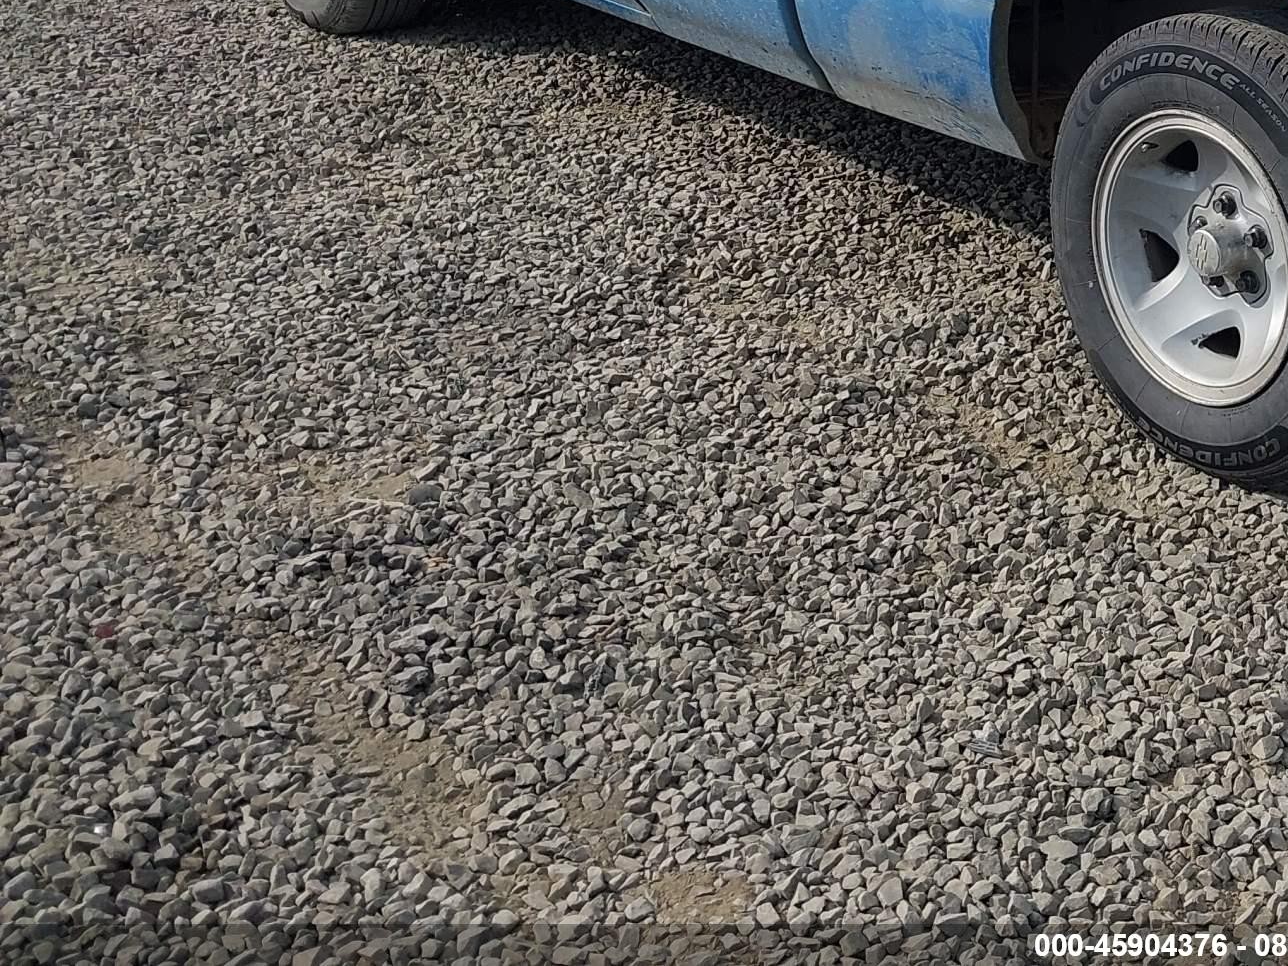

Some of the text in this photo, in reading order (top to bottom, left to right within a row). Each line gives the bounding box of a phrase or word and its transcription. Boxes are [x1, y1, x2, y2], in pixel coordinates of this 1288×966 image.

[1098, 50, 1242, 91] CONFIDENCE
[1239, 82, 1257, 100] ALL
[1256, 97, 1287, 133] SEASON
